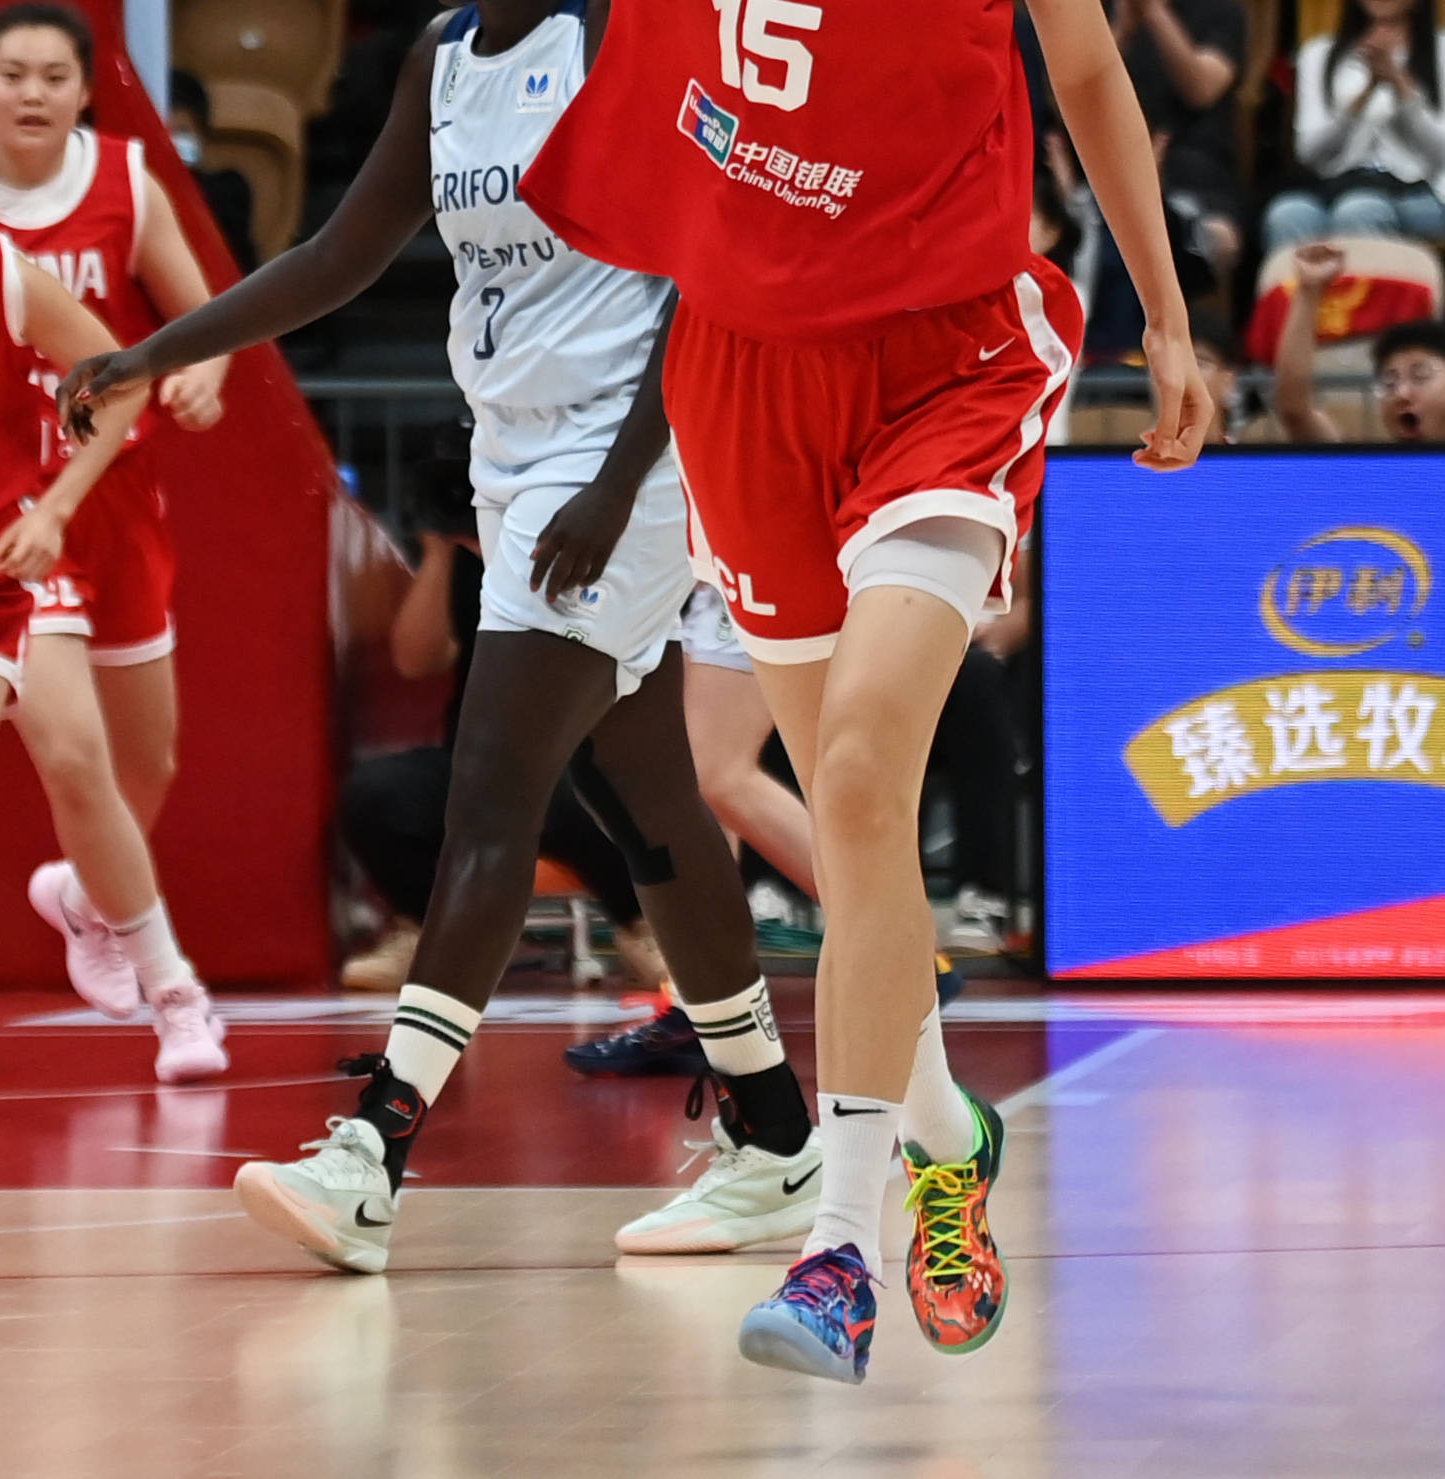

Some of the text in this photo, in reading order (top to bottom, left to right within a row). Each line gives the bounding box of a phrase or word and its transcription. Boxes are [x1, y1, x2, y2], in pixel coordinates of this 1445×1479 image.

[431, 163, 524, 214] GRIFOL
[725, 162, 847, 220] China UnionPay
[733, 141, 864, 198] 中国银联
